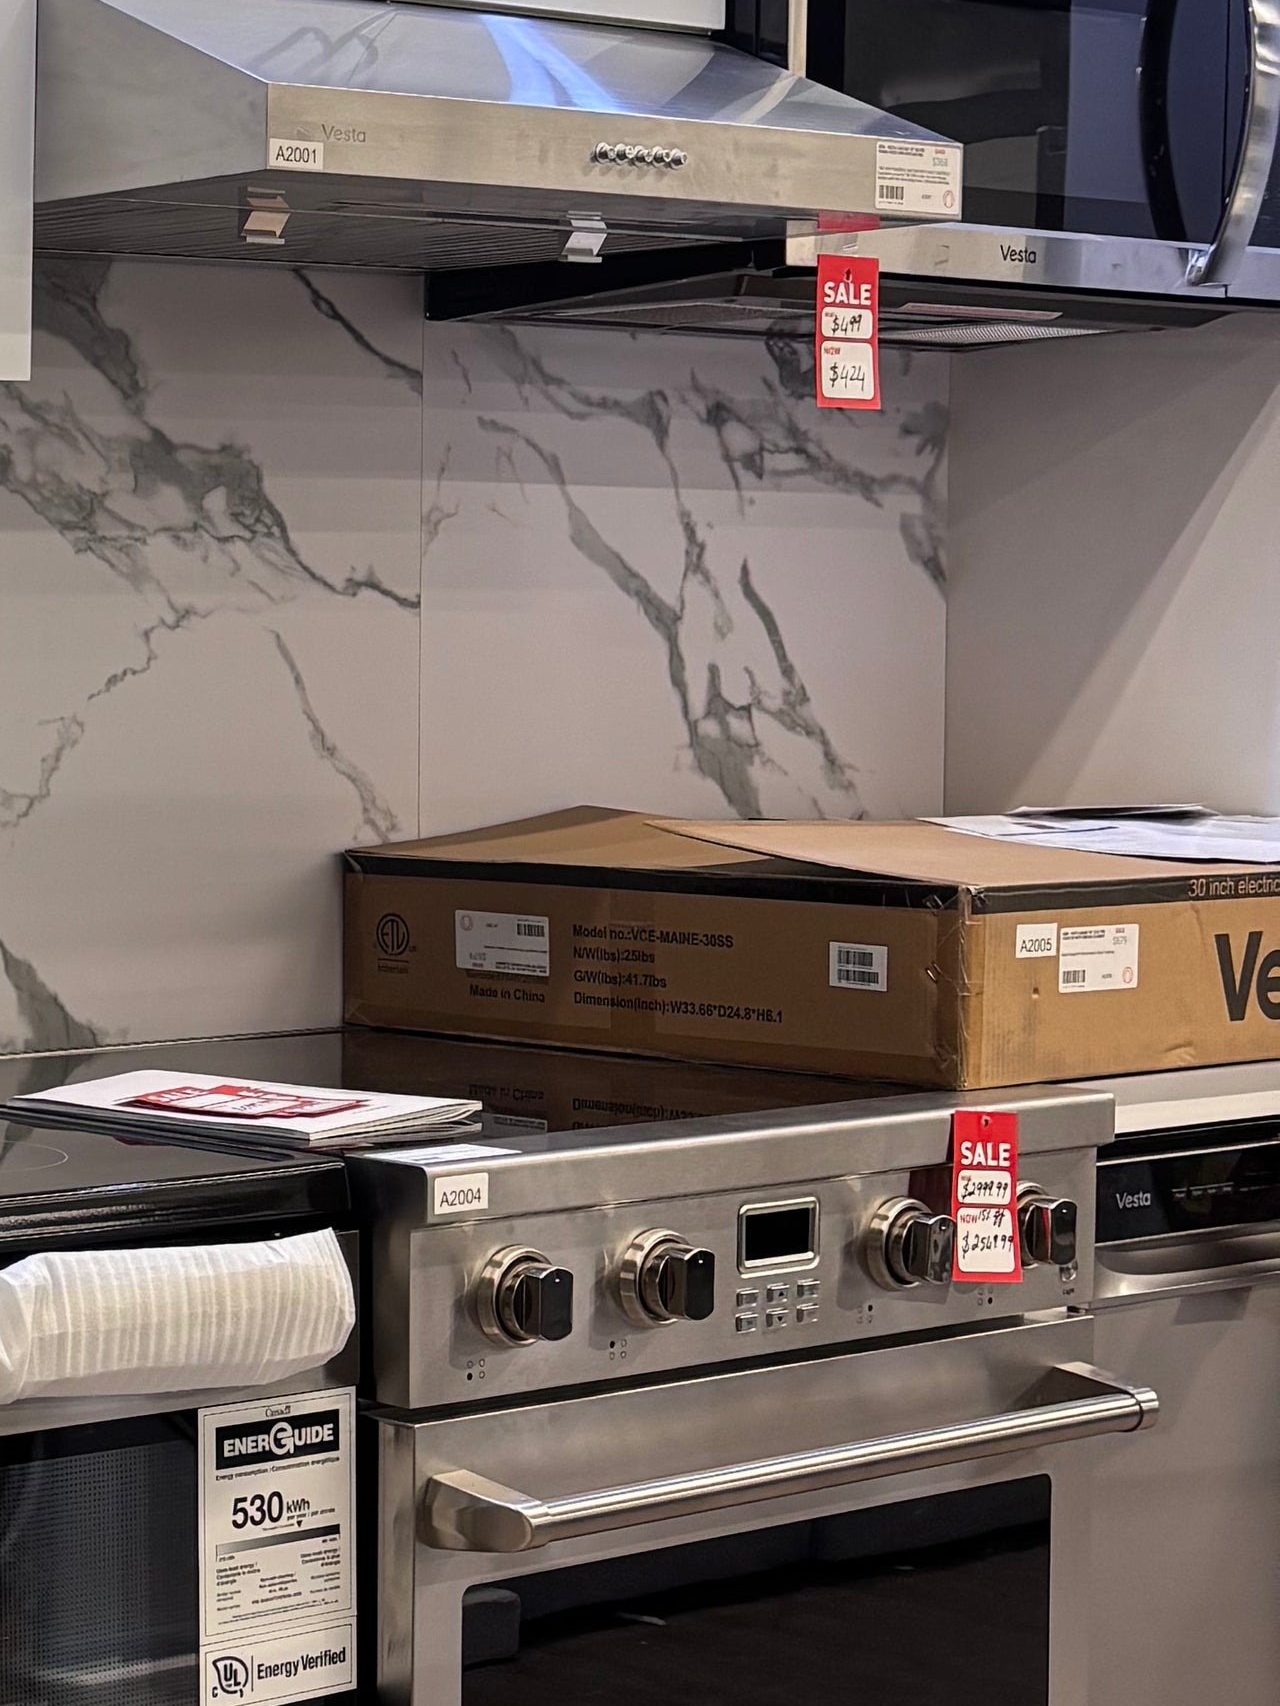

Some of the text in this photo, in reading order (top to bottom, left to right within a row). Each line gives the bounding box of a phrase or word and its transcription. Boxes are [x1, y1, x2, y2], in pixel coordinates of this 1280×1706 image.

[321, 123, 367, 143] Vesta
[275, 145, 317, 164] A2001
[1000, 244, 1037, 264] Vesta
[823, 281, 872, 306] SALE
[829, 362, 865, 392] $424
[1188, 878, 1207, 897] 30
[1208, 878, 1235, 896] inch
[572, 924, 608, 939] Model
[1019, 938, 1053, 953] A2005
[469, 983, 546, 1003] Made in China
[960, 1141, 1011, 1167] SALE
[440, 1187, 482, 1207] A2004
[1115, 1190, 1152, 1210] Vesta
[960, 1214, 978, 1224] NOW
[223, 1421, 334, 1457] ENERGUIDE
[231, 1491, 311, 1529] 530 kWh
[257, 1647, 346, 1680] Energy Verified
